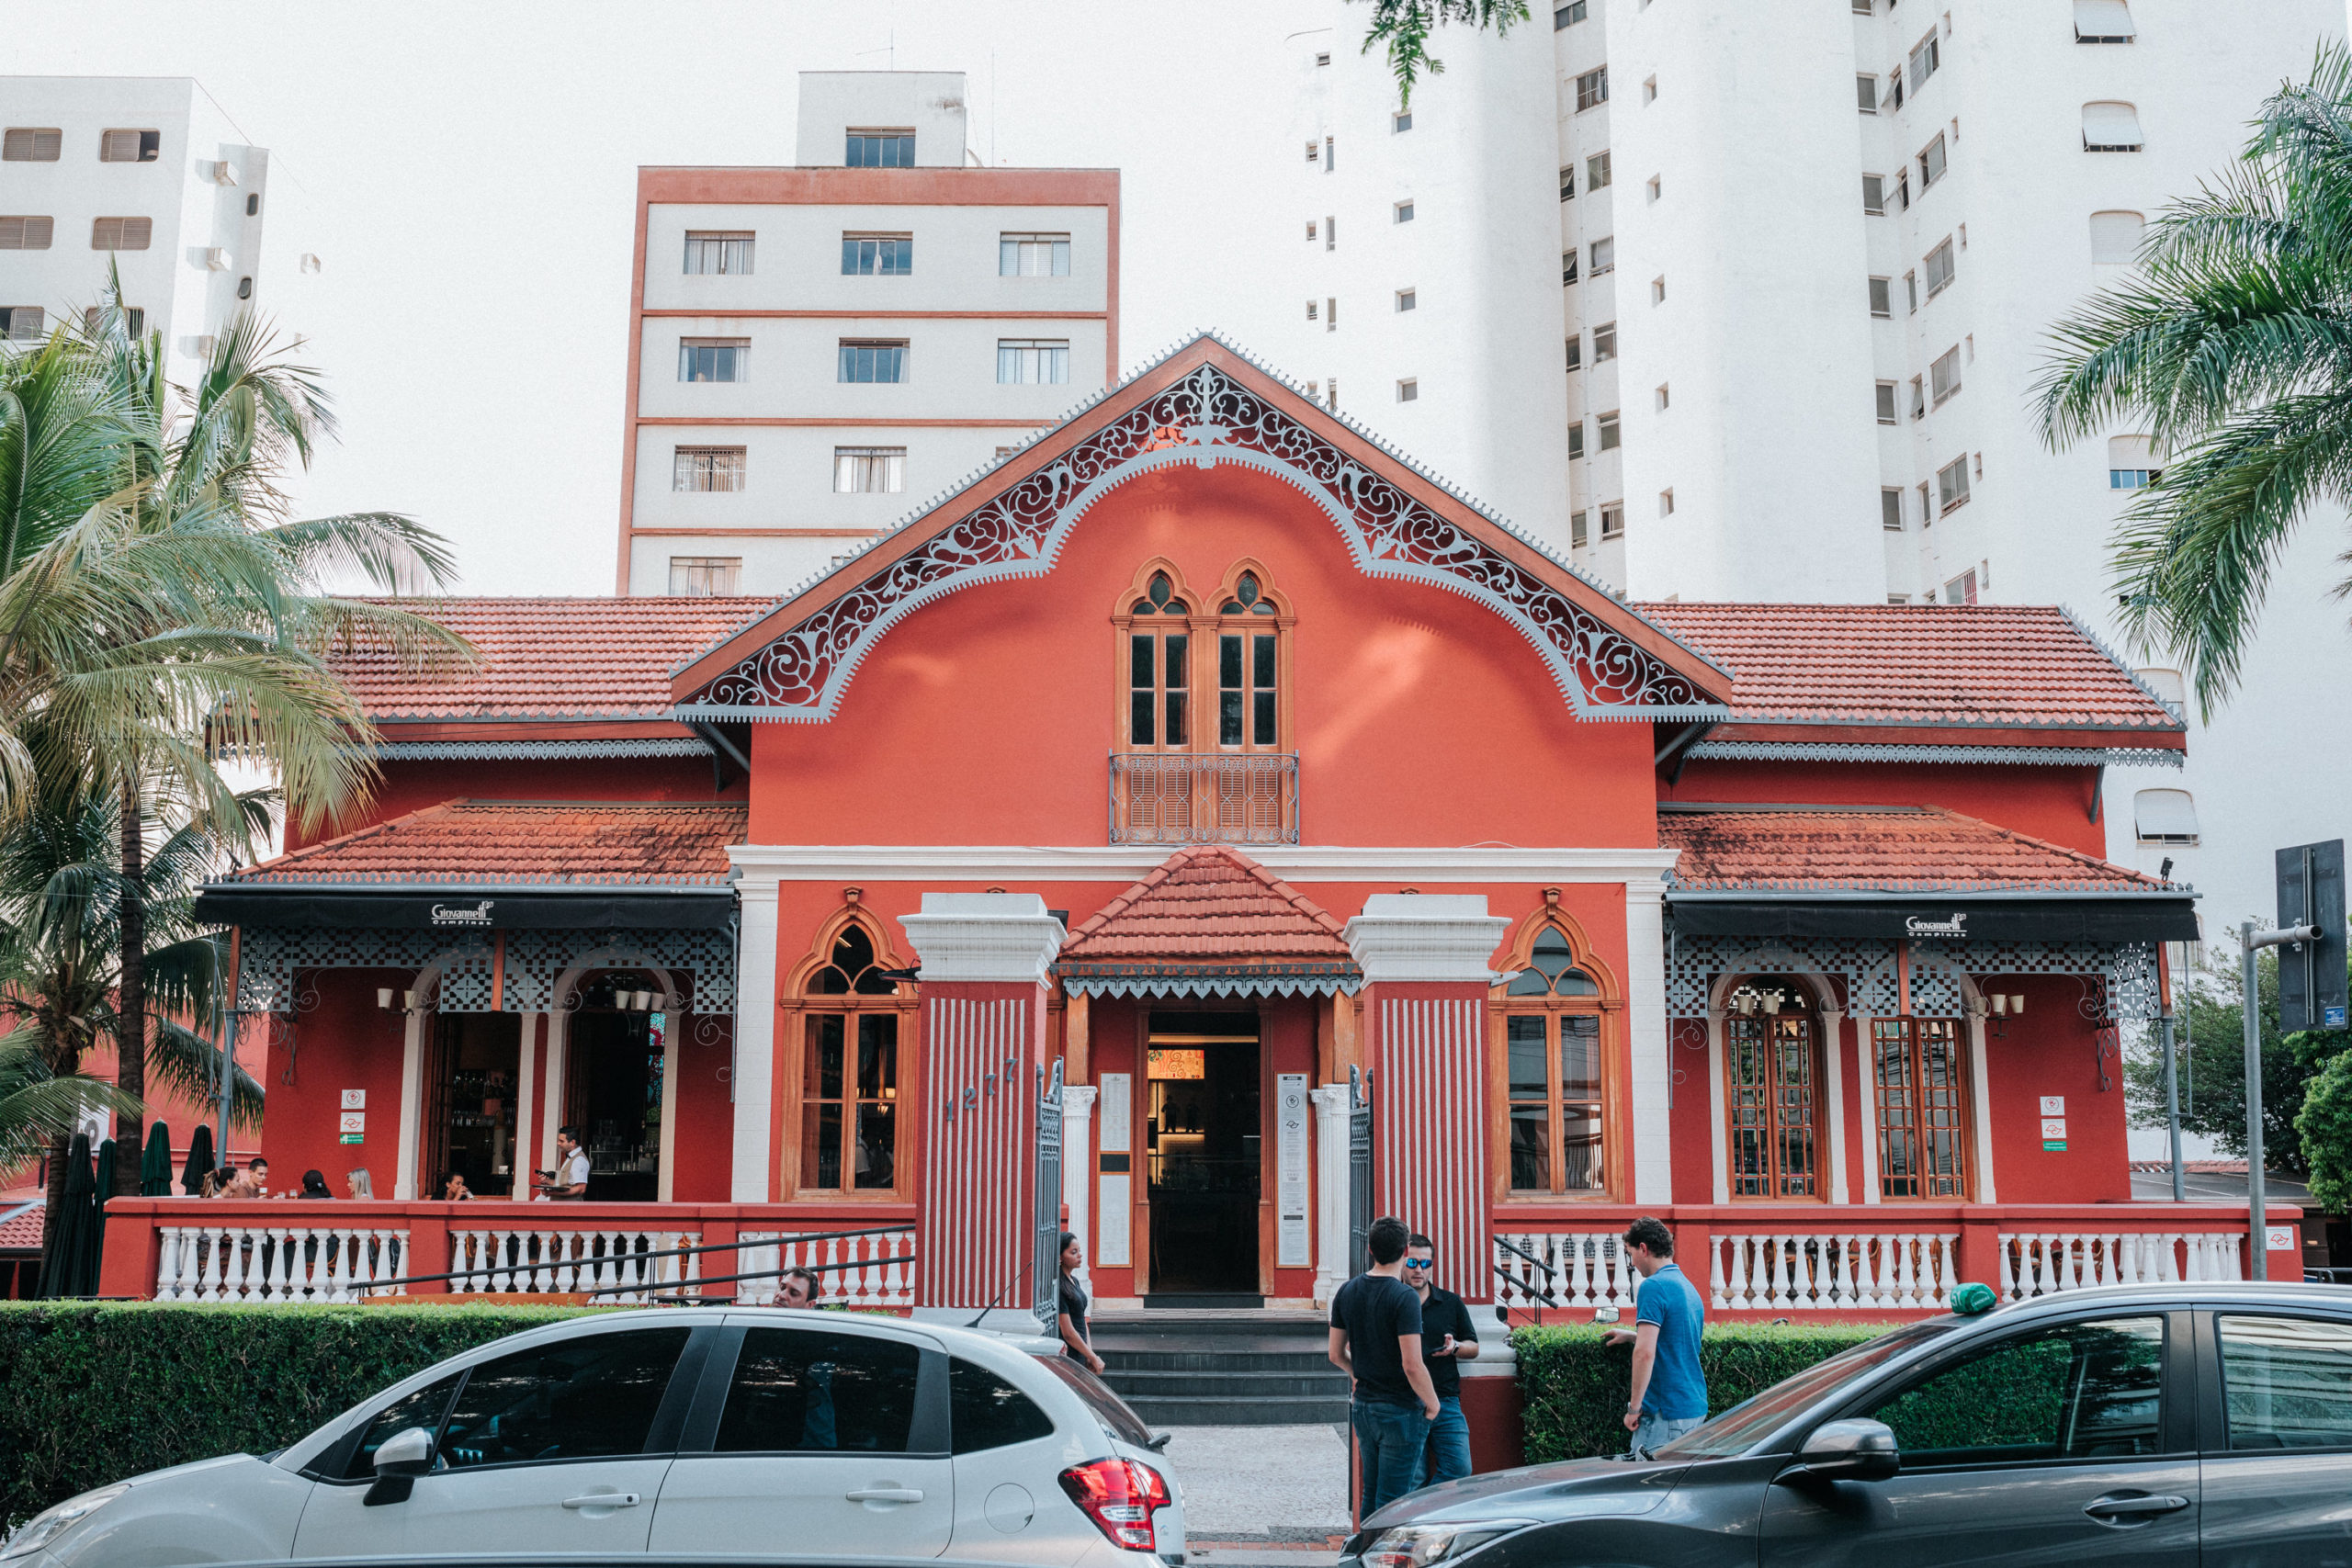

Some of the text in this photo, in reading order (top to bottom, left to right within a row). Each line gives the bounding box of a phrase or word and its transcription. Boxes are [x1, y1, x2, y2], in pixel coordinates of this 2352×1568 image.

[431, 902, 490, 919] Giovannetti
[1905, 914, 1963, 931] Giovannetti
[946, 1058, 1018, 1122] 1277
